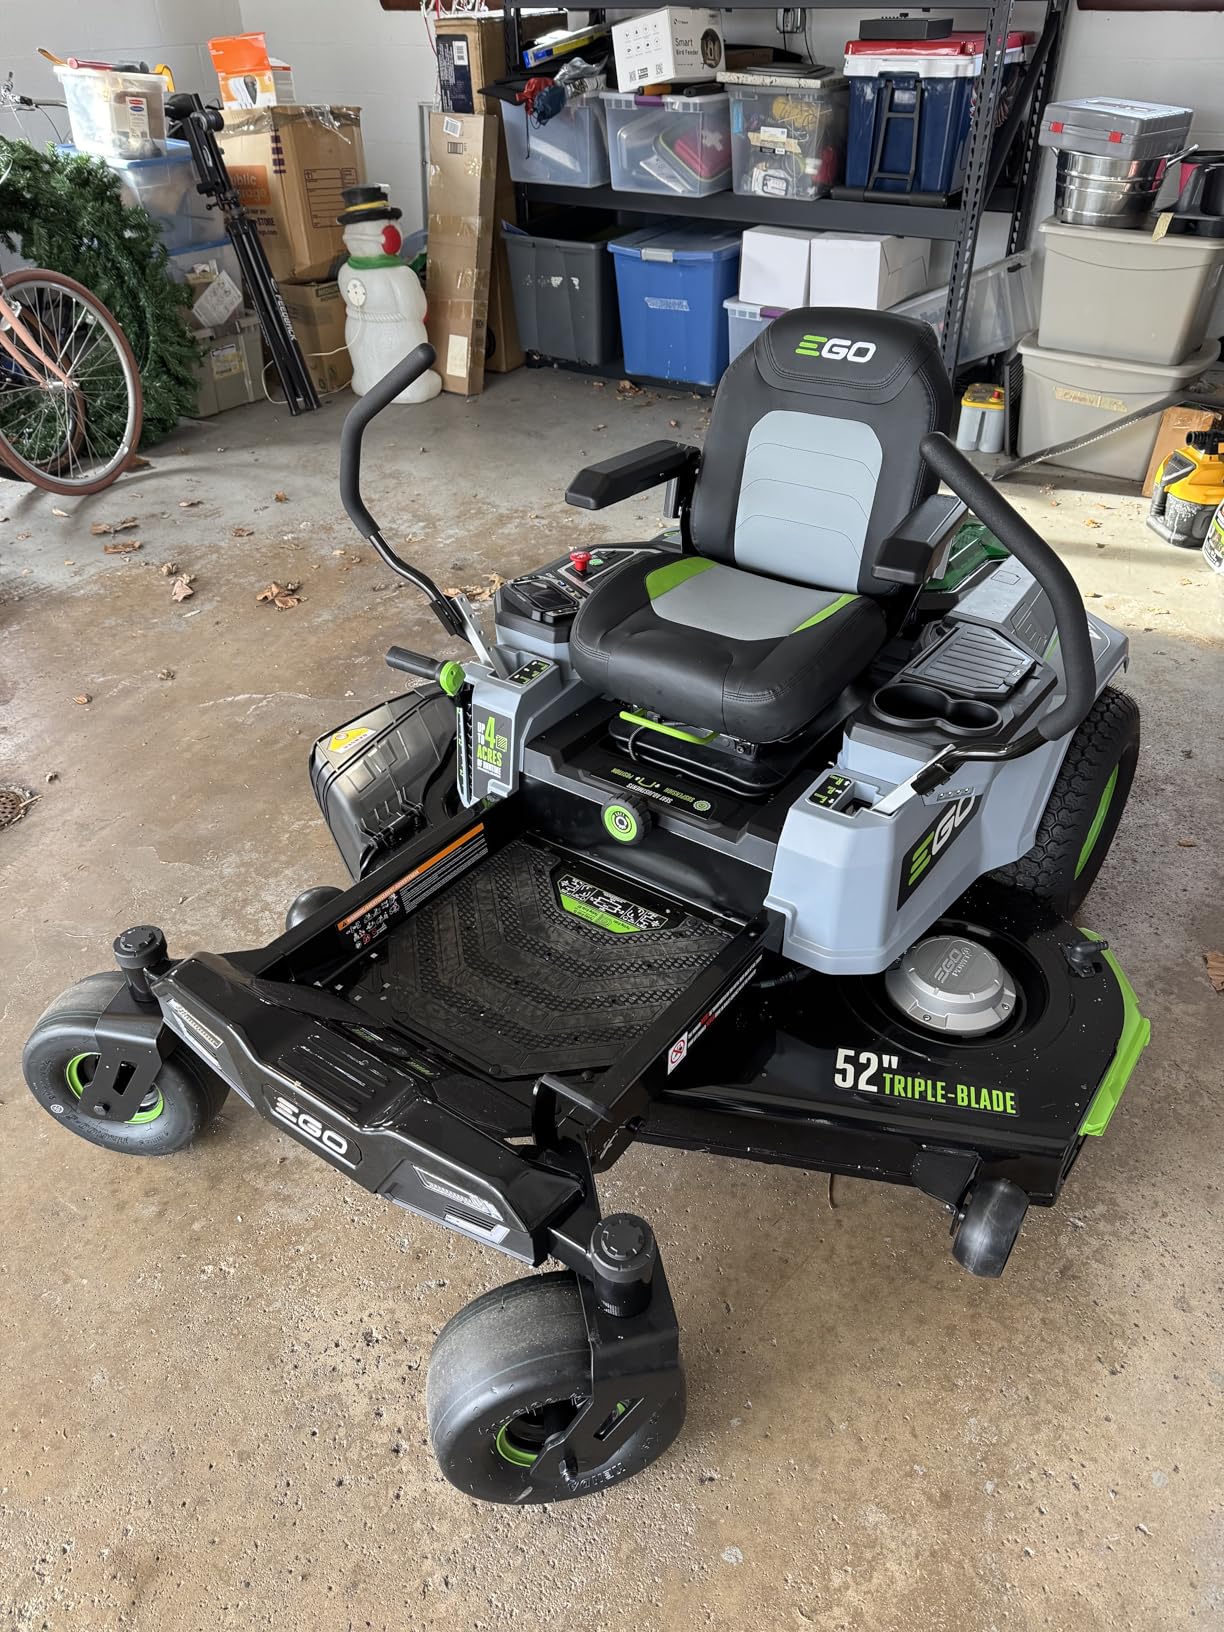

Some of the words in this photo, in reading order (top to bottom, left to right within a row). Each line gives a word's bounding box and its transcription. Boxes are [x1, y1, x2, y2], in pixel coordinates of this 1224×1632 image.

[675, 37, 693, 47] Smart
[795, 334, 876, 363] EGO
[477, 721, 485, 733] UP
[484, 716, 495, 749] 4
[477, 732, 485, 745] TO
[477, 744, 502, 767] ACRES
[908, 796, 976, 886] EGO
[934, 948, 963, 984] EGO
[882, 1072, 1017, 1114] TRIPLE-BLADE
[274, 1096, 348, 1155] EGO
